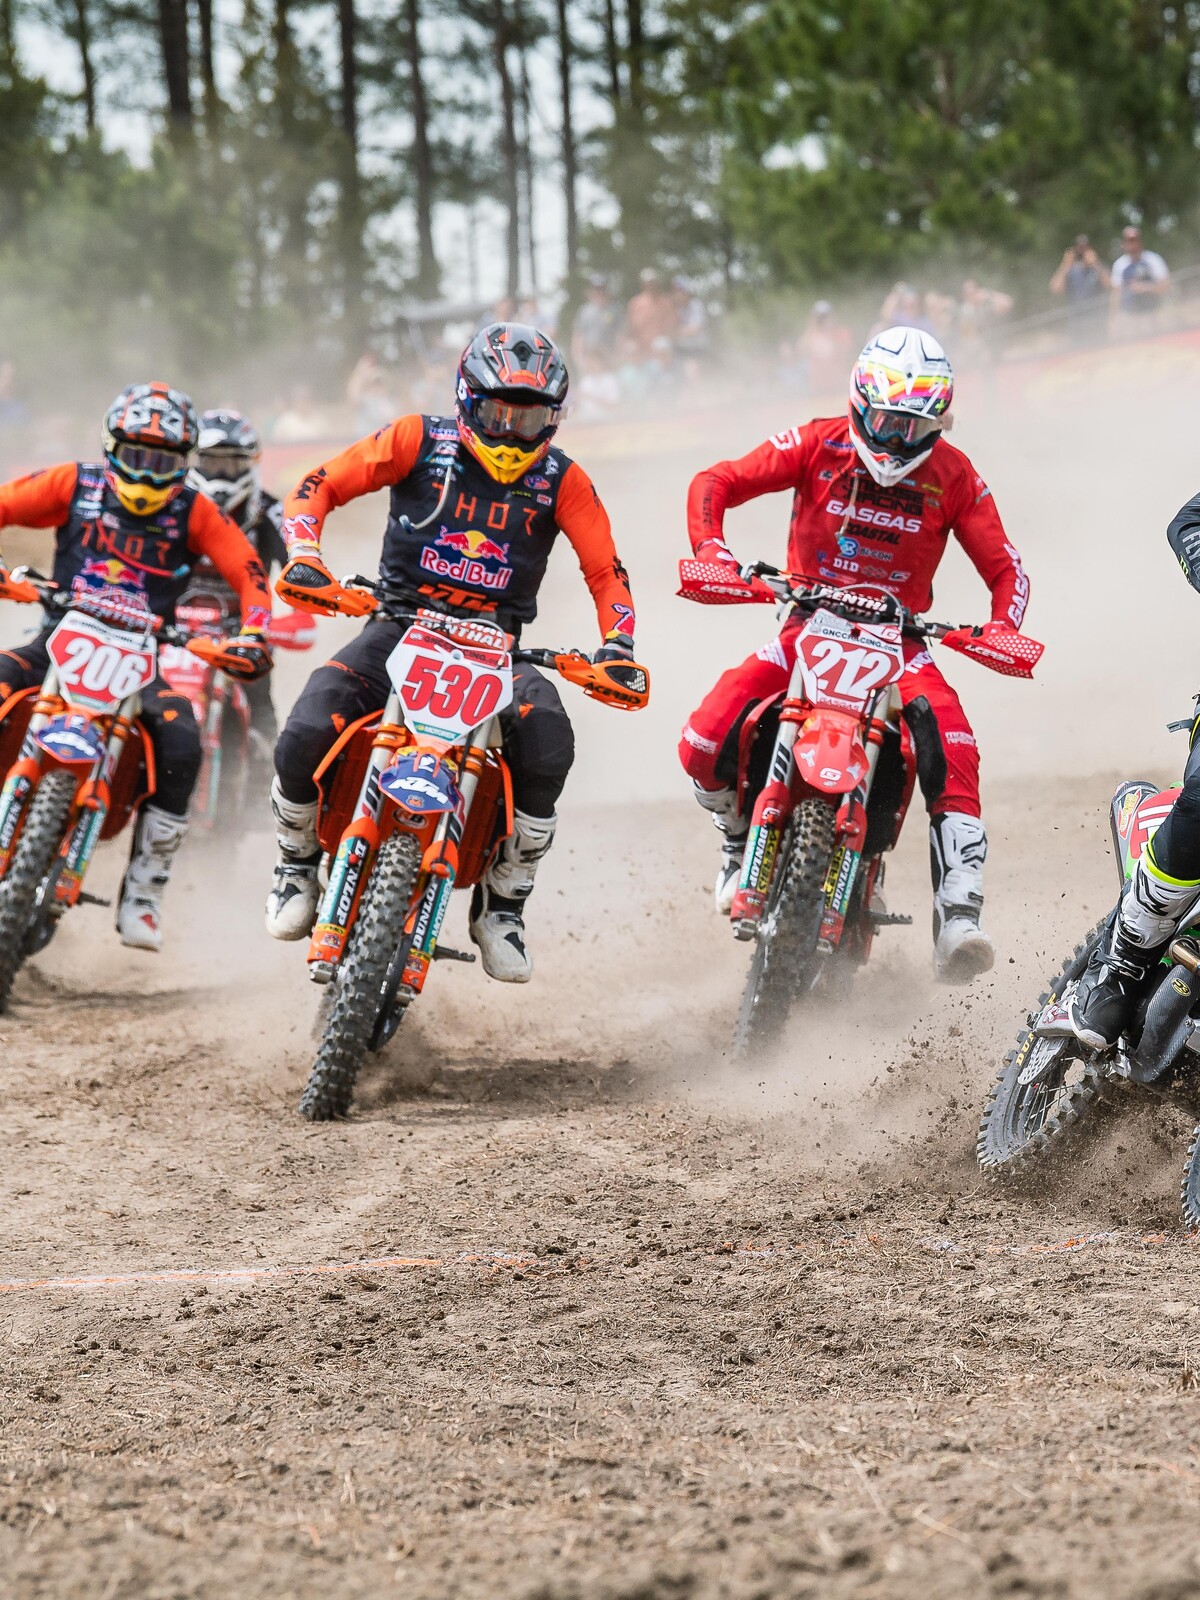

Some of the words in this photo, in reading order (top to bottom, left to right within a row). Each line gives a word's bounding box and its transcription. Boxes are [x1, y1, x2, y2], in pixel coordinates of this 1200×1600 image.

[826, 499, 922, 533] GASGAS
[421, 546, 467, 581] Red
[465, 560, 513, 590] Bull
[57, 637, 148, 700] 206
[401, 655, 503, 727] 530
[811, 640, 892, 701] 212
[388, 777, 448, 804] KTM
